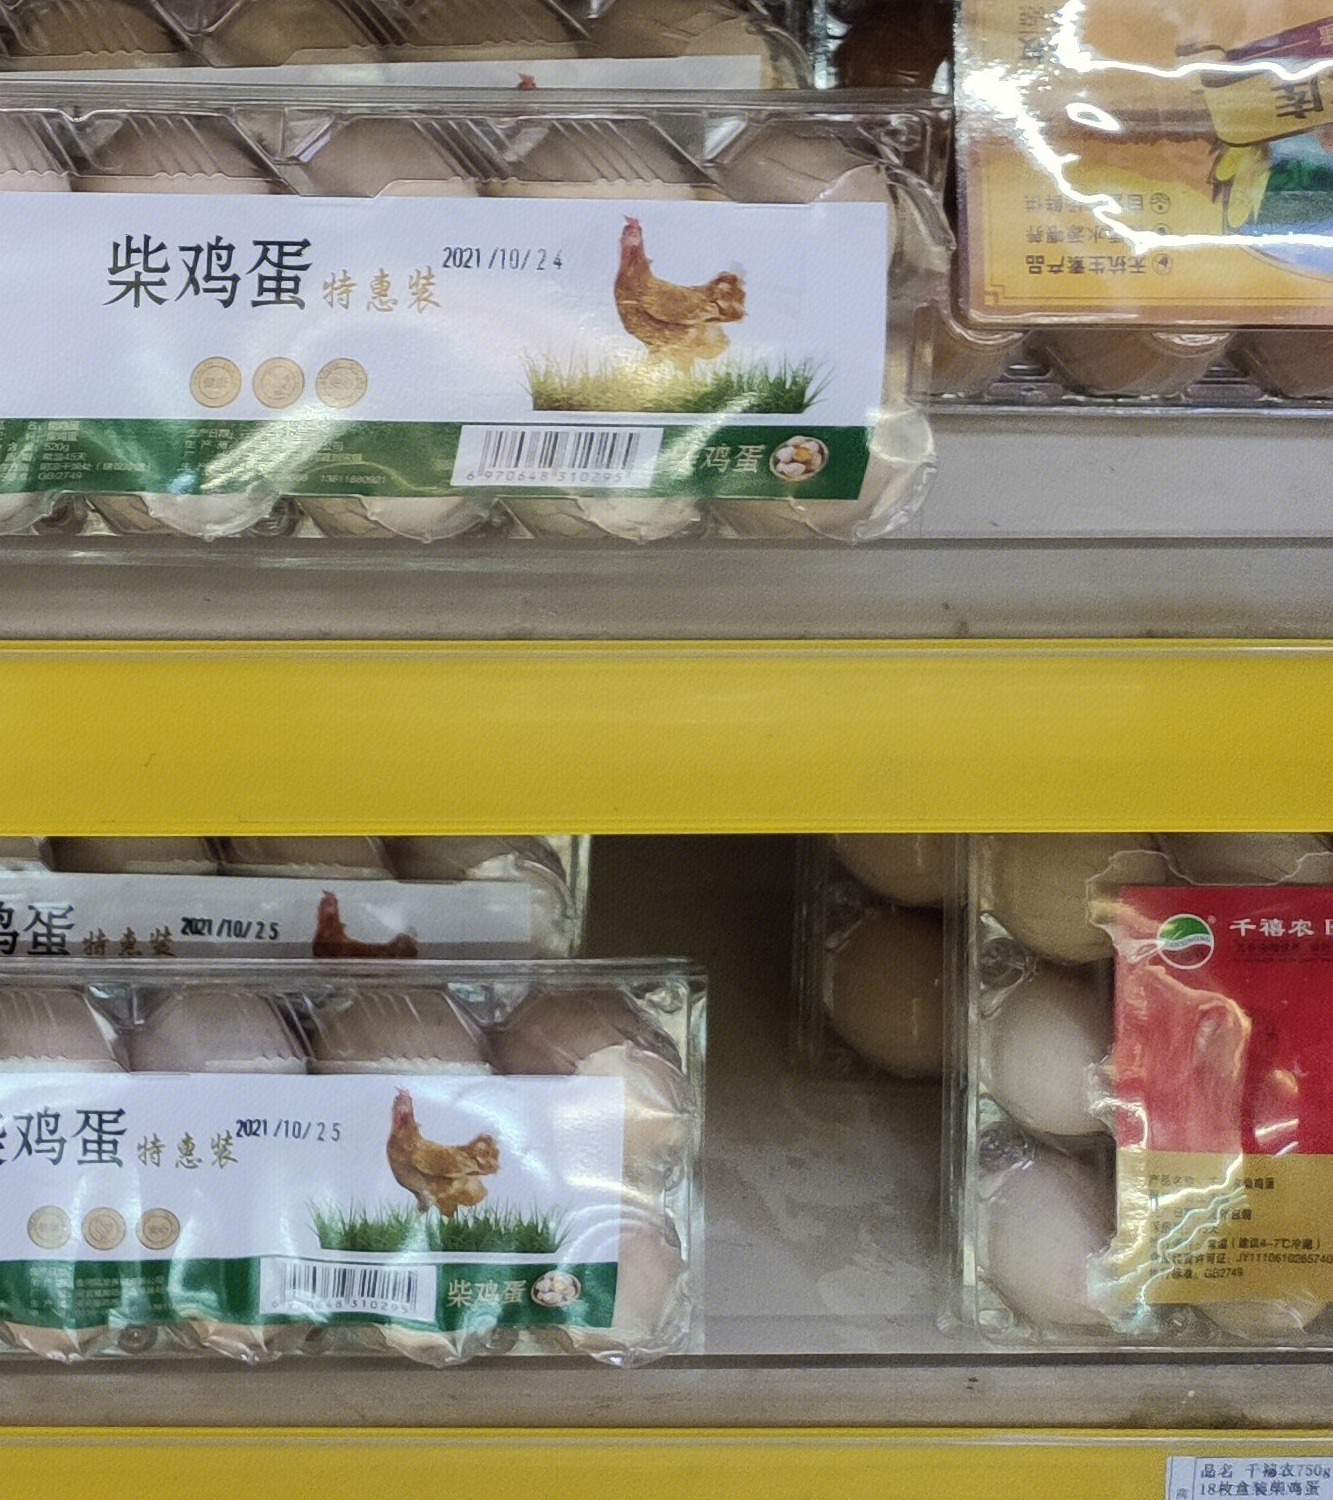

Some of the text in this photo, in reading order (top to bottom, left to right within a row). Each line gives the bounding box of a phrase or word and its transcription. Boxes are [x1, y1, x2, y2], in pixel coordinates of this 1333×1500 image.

[102, 233, 313, 310] 柴鸡蛋
[323, 266, 442, 313] 特惠装
[137, 1128, 238, 1169] 特惠装
[448, 1280, 526, 1307] 柴鸡蛋
